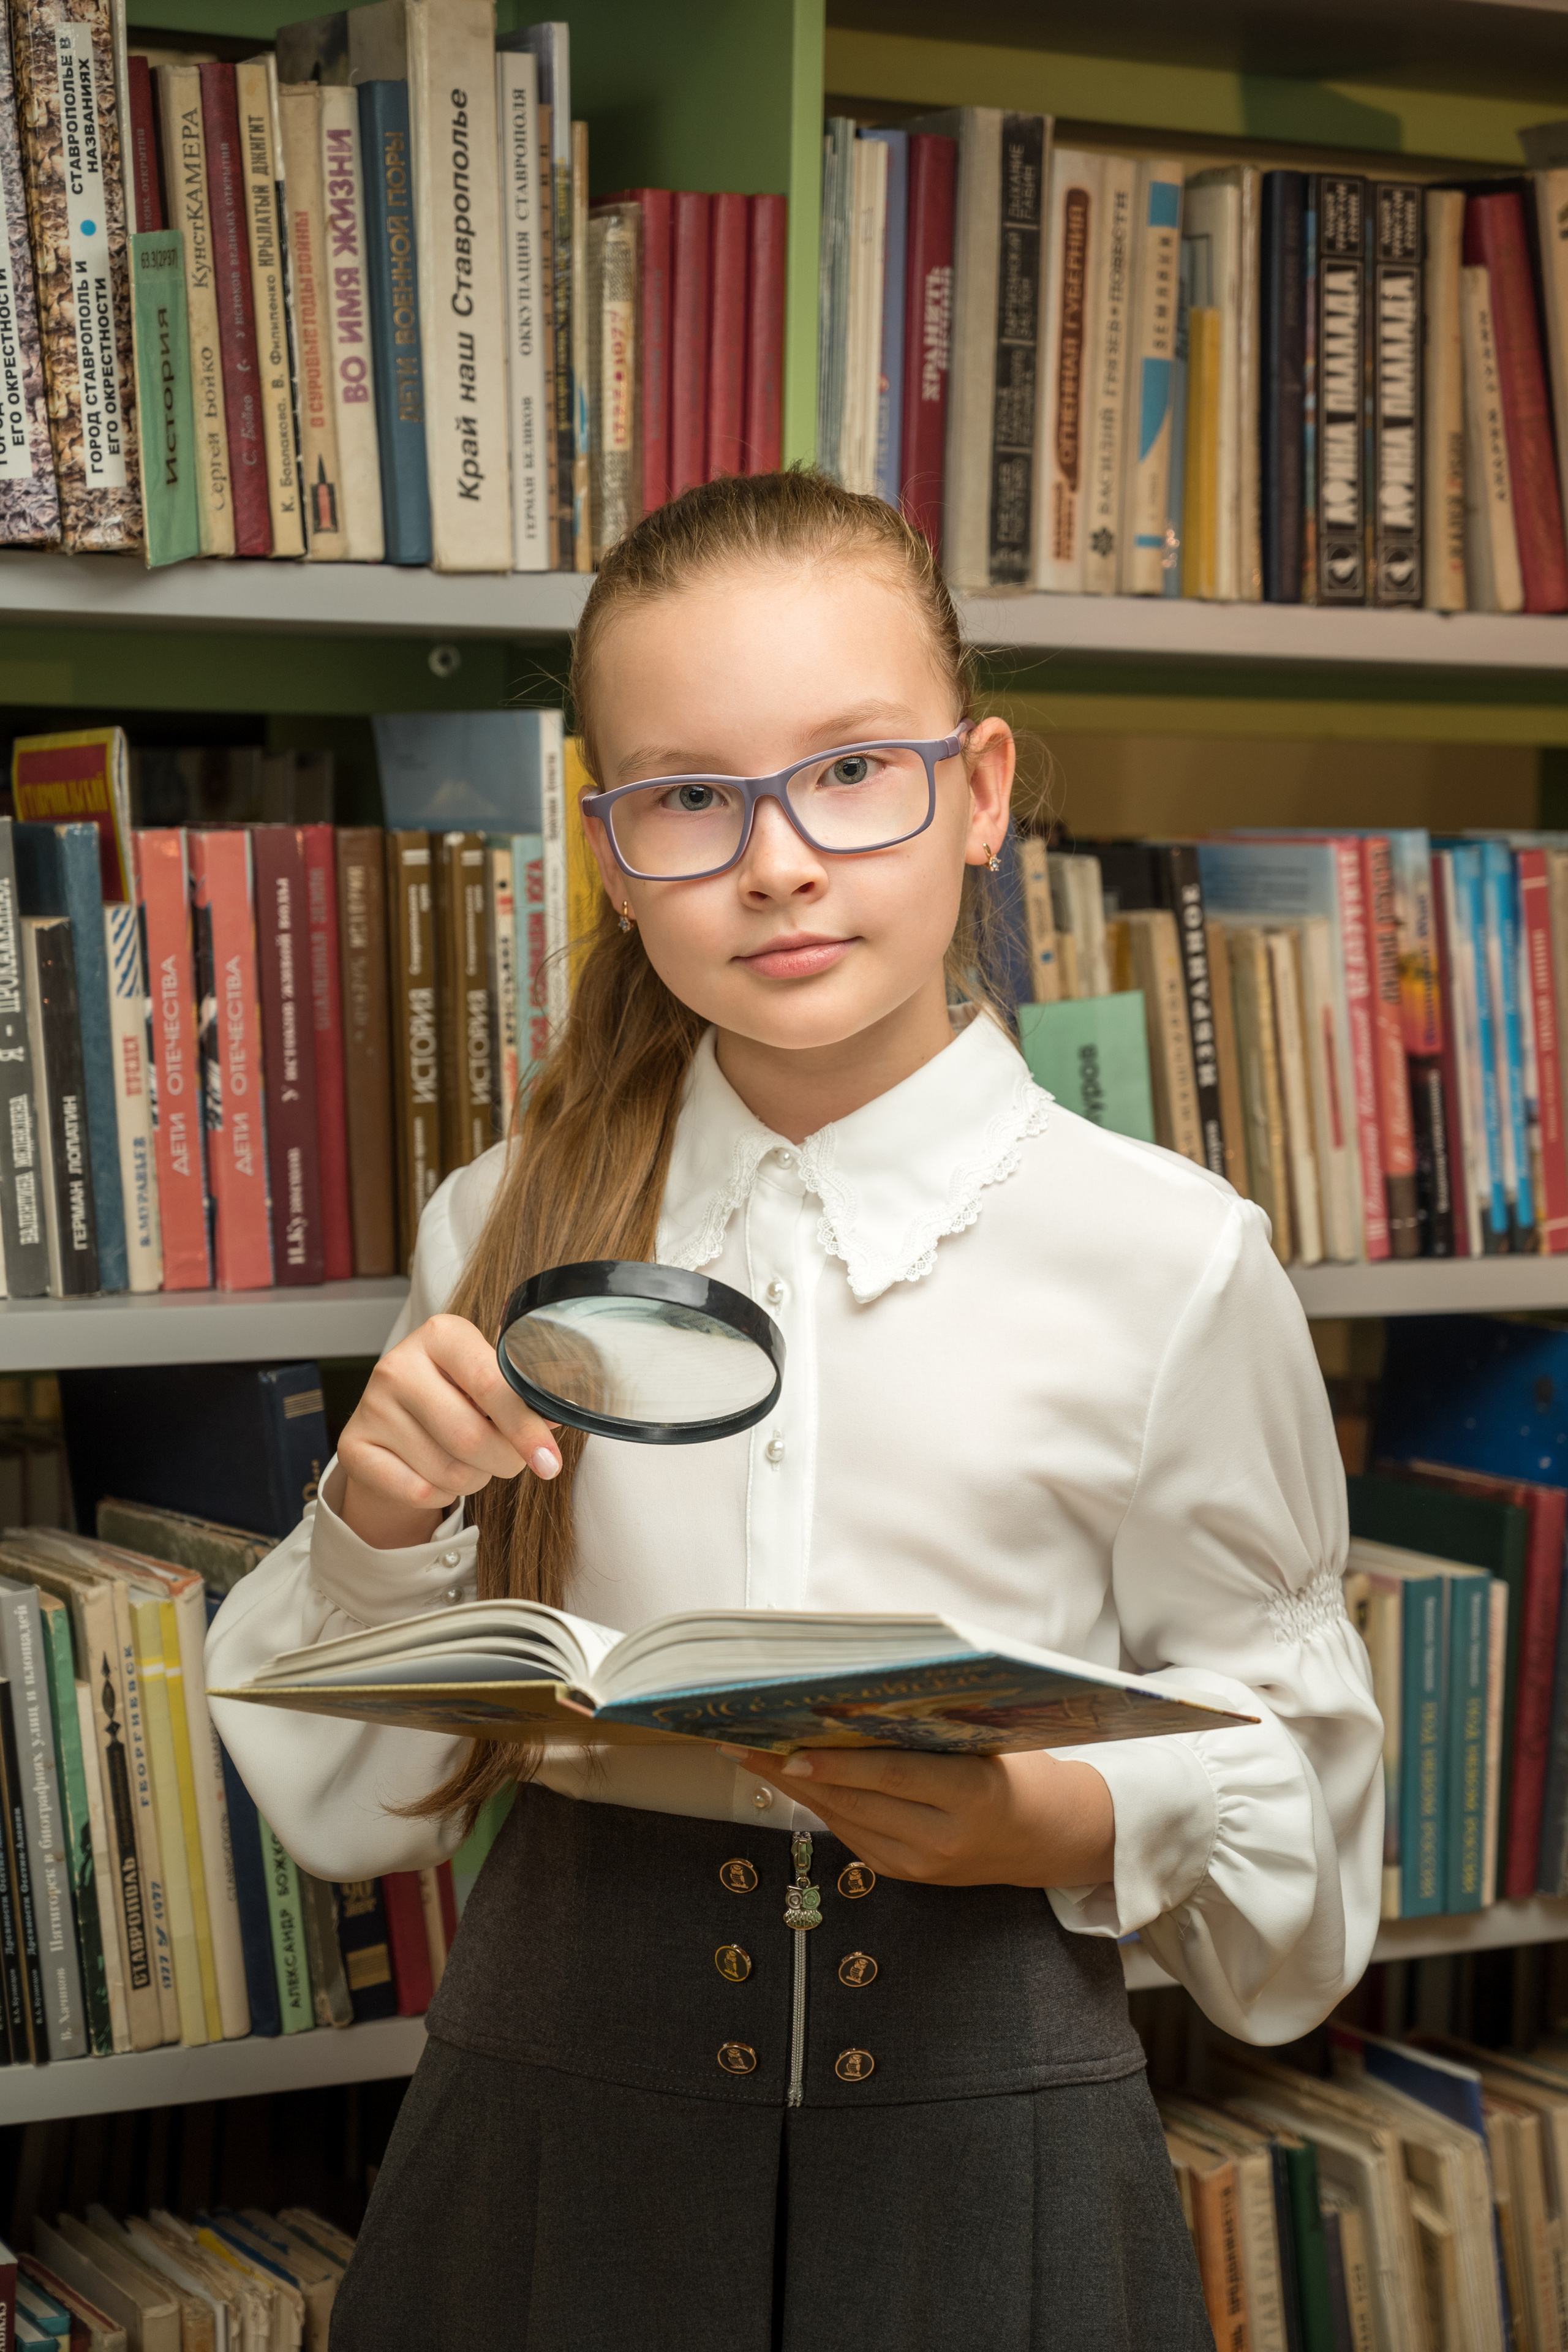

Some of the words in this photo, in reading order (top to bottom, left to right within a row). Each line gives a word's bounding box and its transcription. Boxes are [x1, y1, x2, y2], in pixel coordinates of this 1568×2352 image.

[59, 37, 72, 50] В
[61, 55, 83, 195] СТАВРОПОЛЬЕ
[78, 57, 99, 173] НАЗВАНИЯХ
[246, 114, 270, 176] ДЖИГИТ
[136, 127, 150, 192] ОТКРЫТИЙ
[325, 128, 359, 257] ЖИЗНИ
[383, 131, 407, 207] ПОРЫ
[512, 88, 530, 222] СТАВРОПОЛЯ
[180, 107, 210, 289] КунстКАМЕРА
[251, 185, 275, 268] КРЫЛАТЫЙ
[449, 88, 477, 318] Ставрополье
[75, 260, 88, 274] И
[298, 277, 317, 325] ГОДЫ
[334, 267, 364, 344] ИМЯ
[386, 216, 416, 345] ВОЕННОЙ
[516, 232, 533, 356] ОККУПАЦИЯ
[77, 279, 98, 406] СТАВРОПОЛЬ
[95, 277, 116, 415] ОКРЕСТНОСТИ
[302, 329, 324, 413] СУРОВЫЕ
[339, 355, 369, 405] ВО
[456, 332, 477, 404] наш
[155, 307, 179, 486] История
[270, 374, 284, 389] В.
[395, 357, 423, 423] ДЕТИ
[9, 411, 25, 447] ЕГО
[87, 411, 104, 474] ГОРОД
[105, 420, 121, 456] ЕГО
[454, 416, 484, 503] Край
[281, 496, 295, 513] К.
[276, 878, 291, 930] воды
[274, 933, 295, 999] живой
[1182, 884, 1218, 1088] ИЗБРАННОЕ
[160, 954, 184, 1096] ОТЕЧЕСТВА
[224, 954, 247, 1096] ОТЕЧЕСТВА
[409, 987, 437, 1102] ИСТОРИЯ
[467, 989, 491, 1105] ИСТОРИЯ
[9, 1093, 35, 1169] МЕДВЕДЕВА
[280, 1088, 300, 1102] У
[62, 1094, 83, 1175] ЛОПАТИН
[169, 1113, 192, 1177] ДЕТИ
[233, 1113, 254, 1177] ДЕТИ
[15, 1172, 39, 1246] ВАЛЕНТИНА
[69, 1180, 88, 1251] ГЕРМАН
[13, 1604, 35, 1686] площадей
[26, 1690, 37, 1702] и
[28, 1705, 46, 1747] улиц
[123, 1643, 152, 1808] ГЕОРГИЕВСК
[32, 1752, 53, 1850] биографиях
[1, 1896, 15, 1955] Древности
[22, 1896, 37, 1956] Древности
[44, 1869, 64, 1953] Пятигорск
[124, 1858, 150, 1988] СТАВРОПОЛЬ
[277, 1908, 301, 2009] АЛЕКСАНДР
